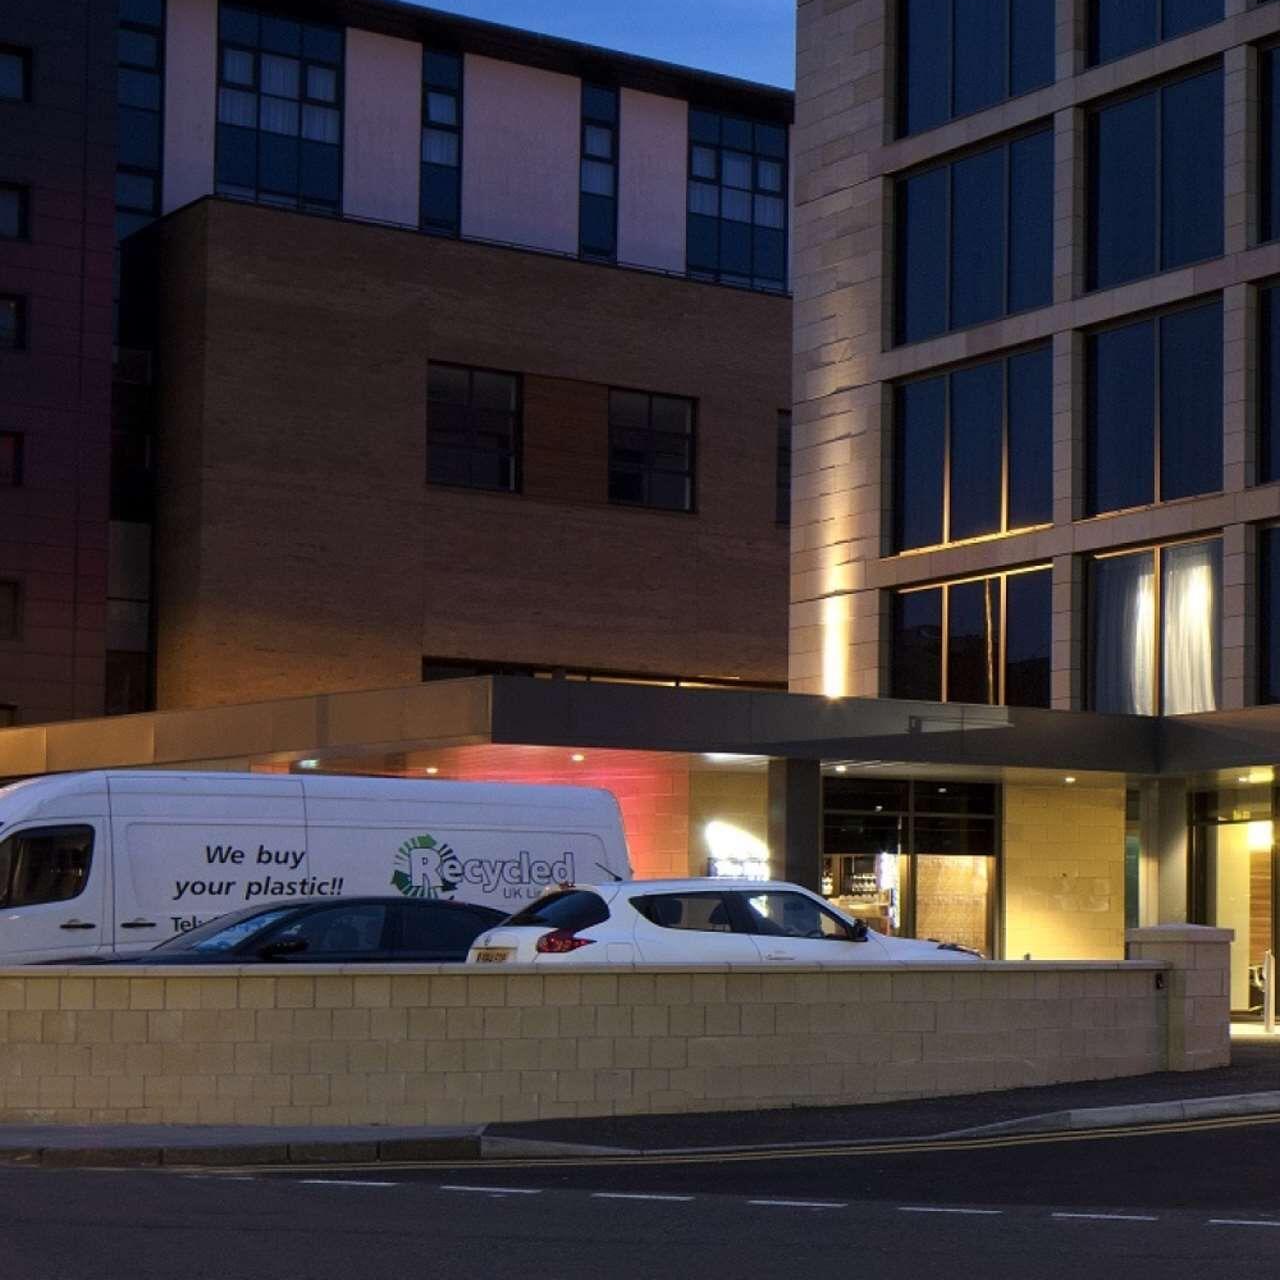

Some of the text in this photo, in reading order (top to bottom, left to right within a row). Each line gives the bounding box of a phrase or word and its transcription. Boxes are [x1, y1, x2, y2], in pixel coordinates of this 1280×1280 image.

[206, 844, 306, 869] We buy
[408, 847, 576, 894] Recycled
[172, 876, 345, 901] your plastic!!
[503, 886, 522, 898] UK
